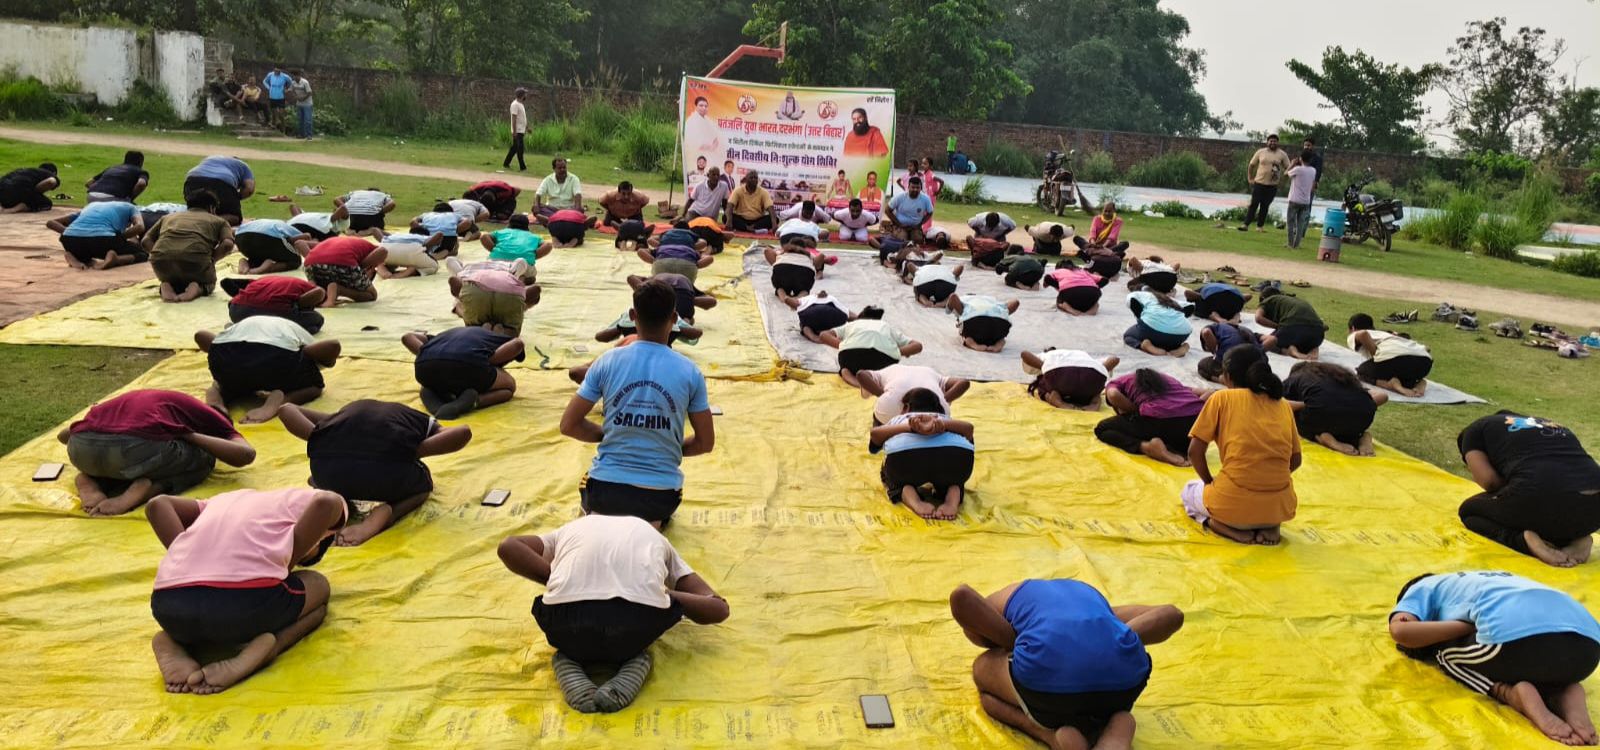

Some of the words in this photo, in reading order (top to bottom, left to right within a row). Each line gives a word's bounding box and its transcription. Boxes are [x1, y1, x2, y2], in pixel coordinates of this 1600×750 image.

[717, 117, 743, 131] पतंजलि
[744, 121, 757, 135] युवा
[726, 147, 740, 161] तीन
[742, 149, 769, 163] दिवसीय
[801, 154, 815, 166] योग
[816, 155, 837, 168] शिविर
[613, 411, 671, 430] SACHIN
